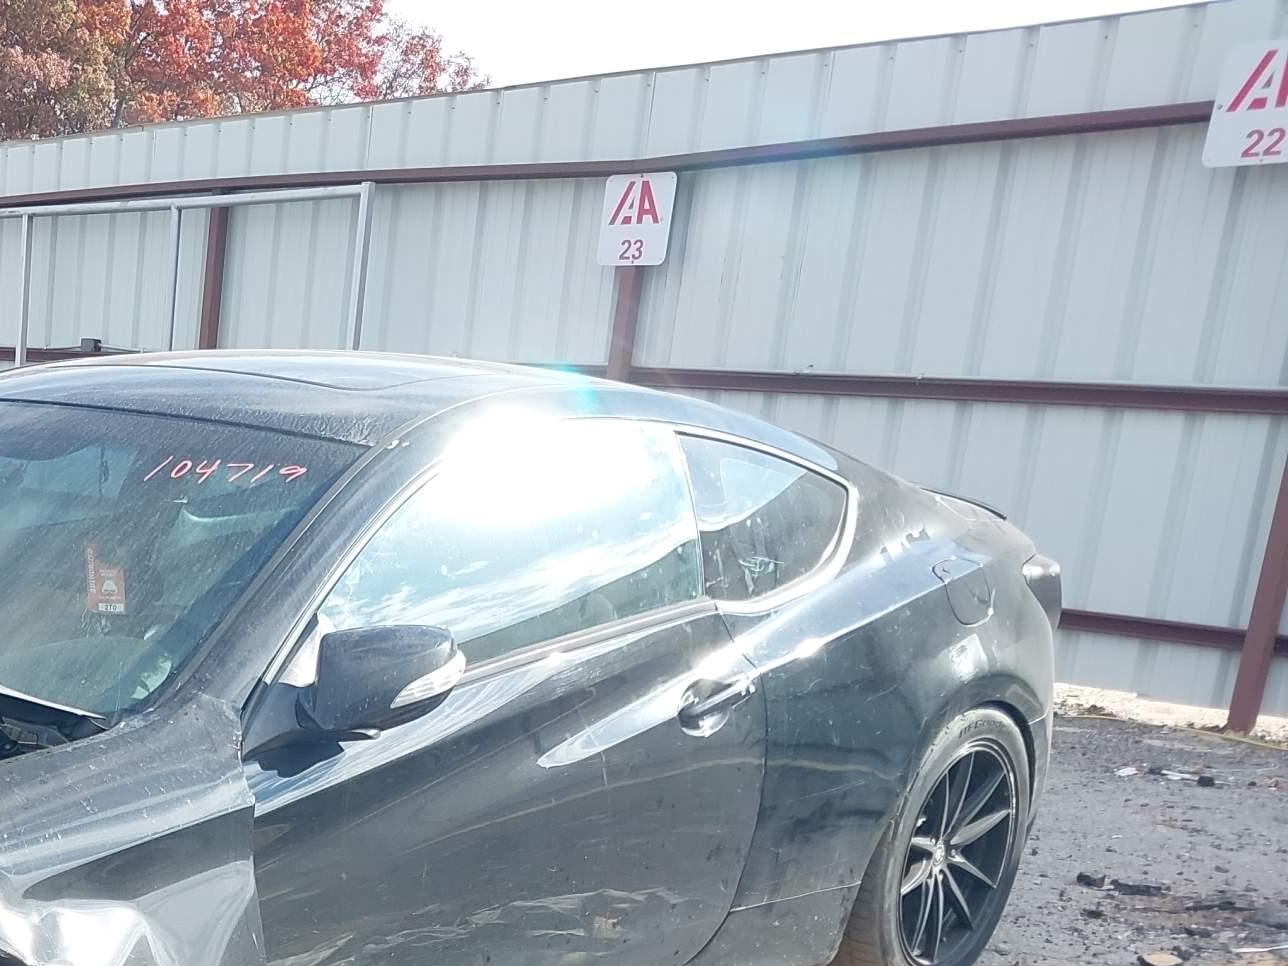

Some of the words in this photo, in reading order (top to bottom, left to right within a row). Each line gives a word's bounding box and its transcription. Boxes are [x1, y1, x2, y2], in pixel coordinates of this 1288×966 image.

[1240, 127, 1286, 159] 22
[618, 239, 644, 261] 23
[143, 455, 308, 485] 104719
